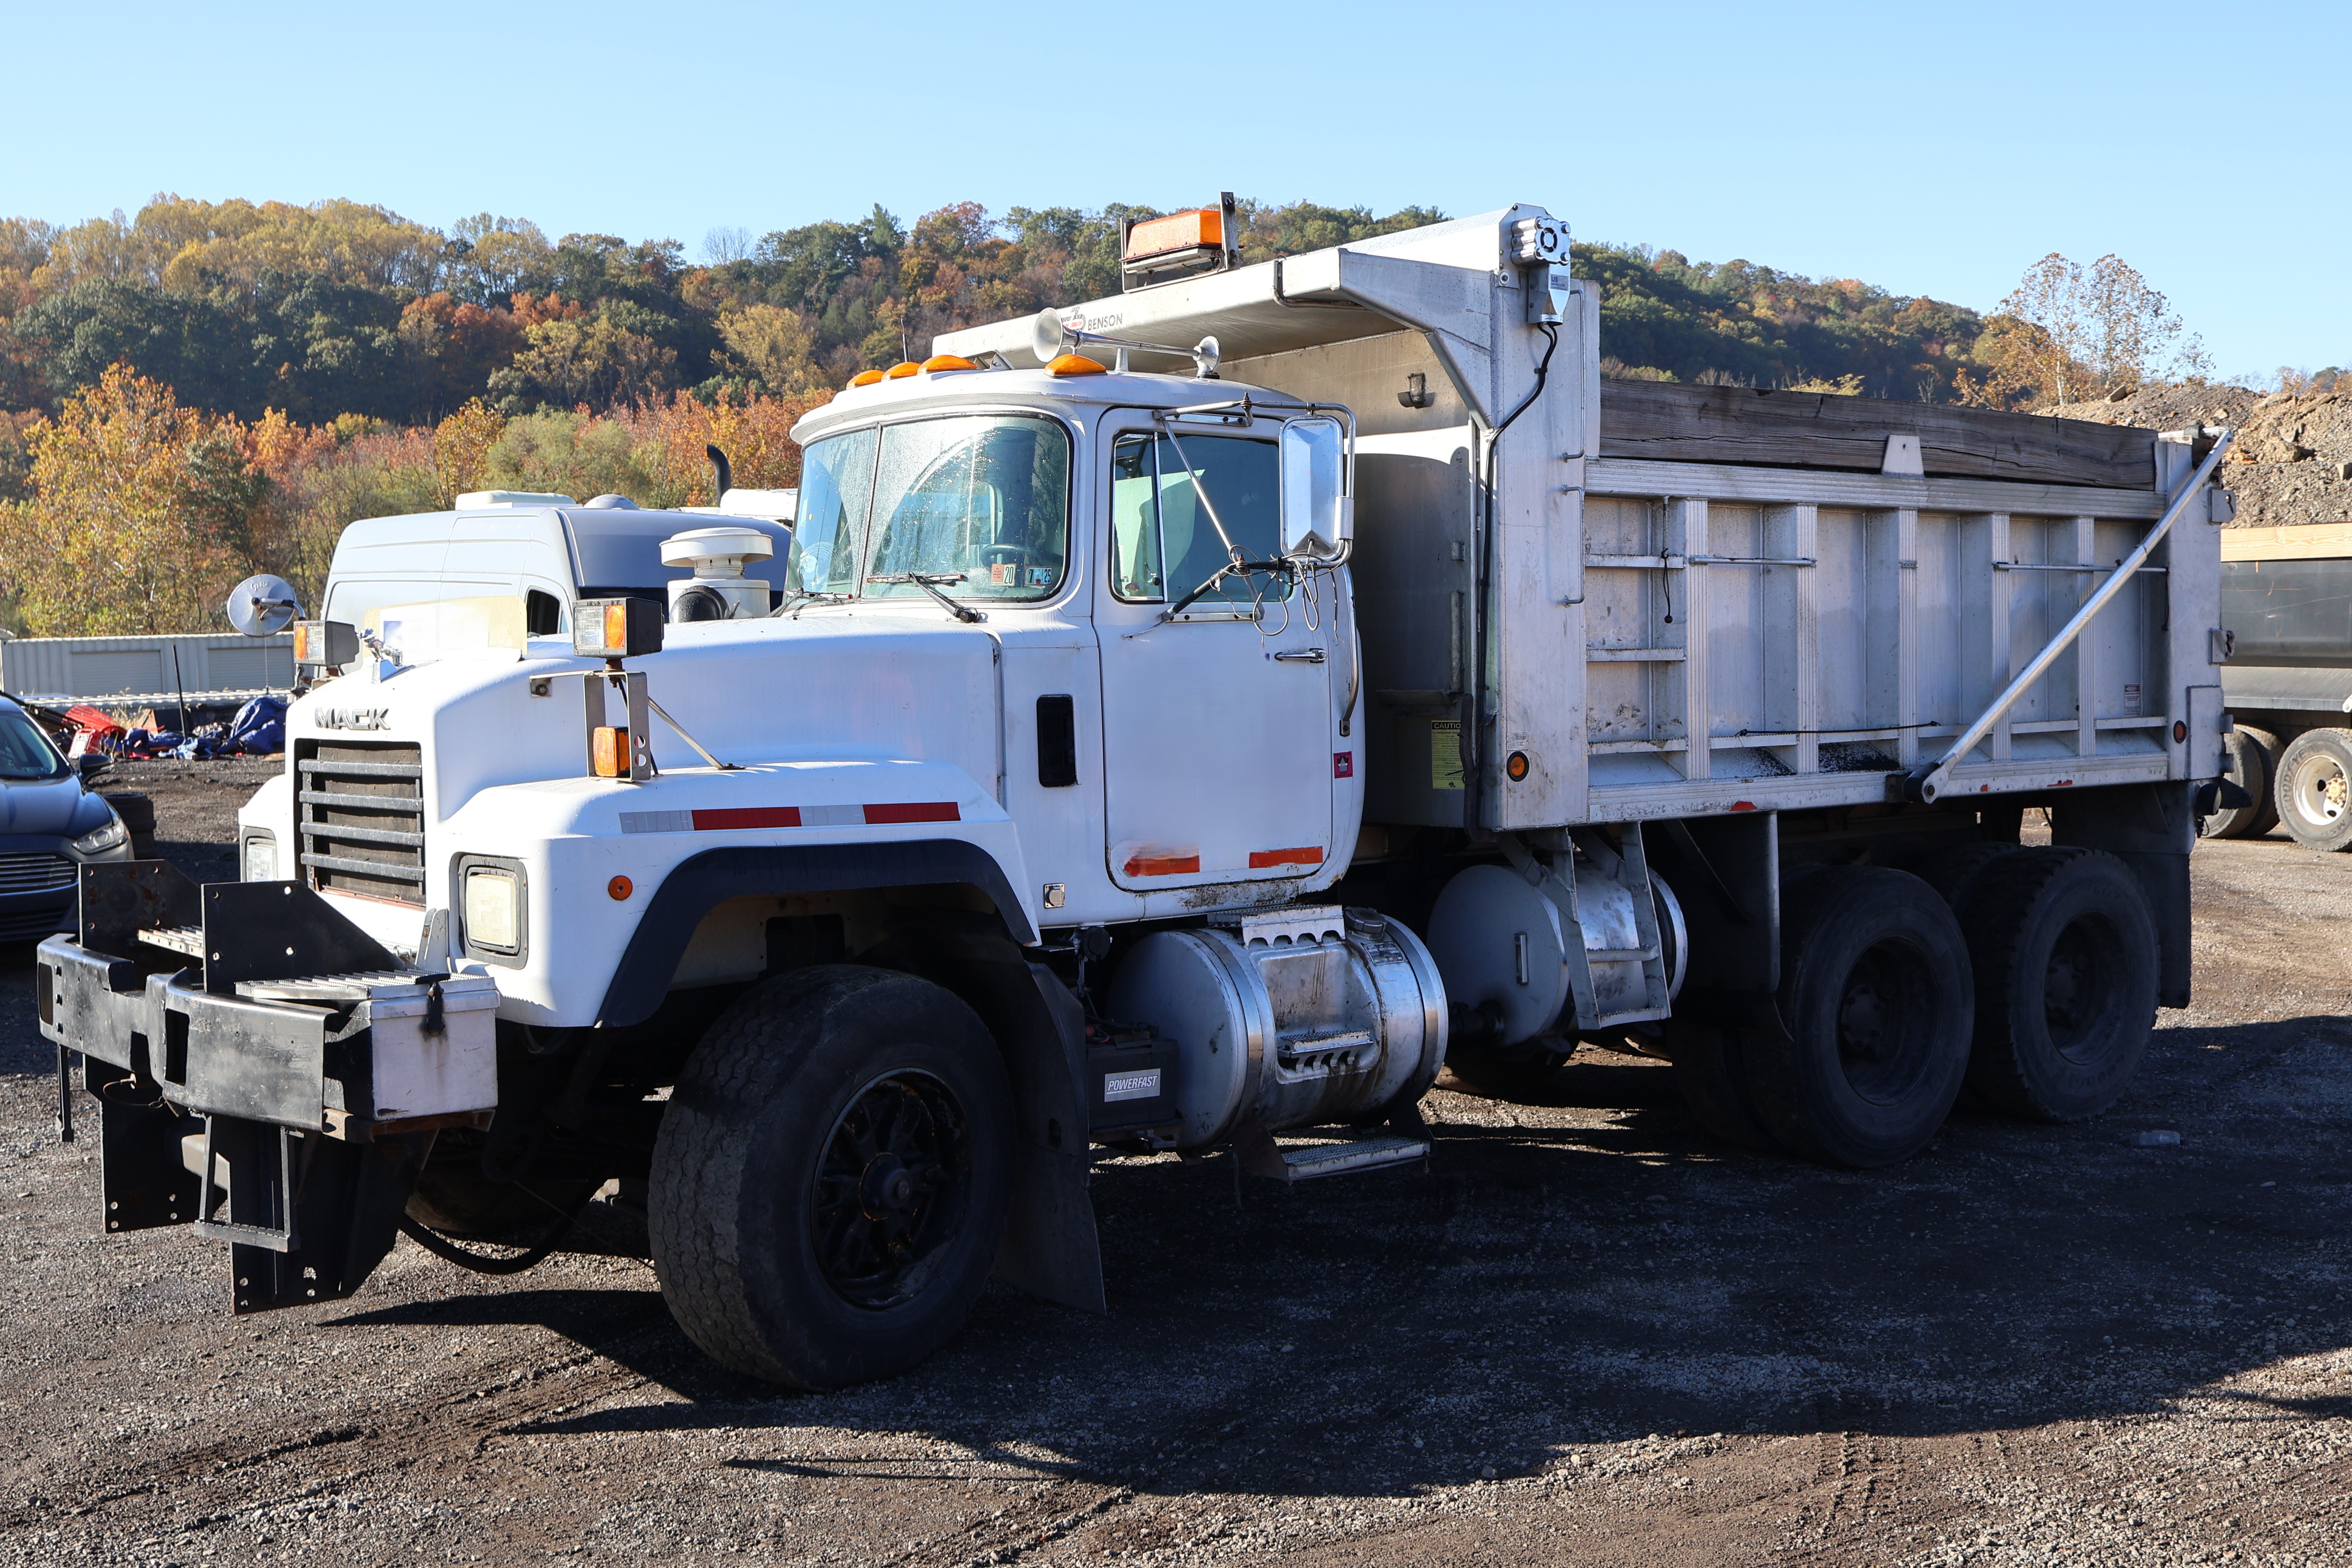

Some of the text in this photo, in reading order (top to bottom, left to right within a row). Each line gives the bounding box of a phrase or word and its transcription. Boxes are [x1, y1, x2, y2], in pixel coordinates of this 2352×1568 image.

[1088, 313, 1123, 330] BENSON
[1004, 566, 1014, 584] 20
[1044, 569, 1051, 583] 25
[315, 706, 390, 731] MACK
[1107, 1075, 1158, 1092] POWERFAST
